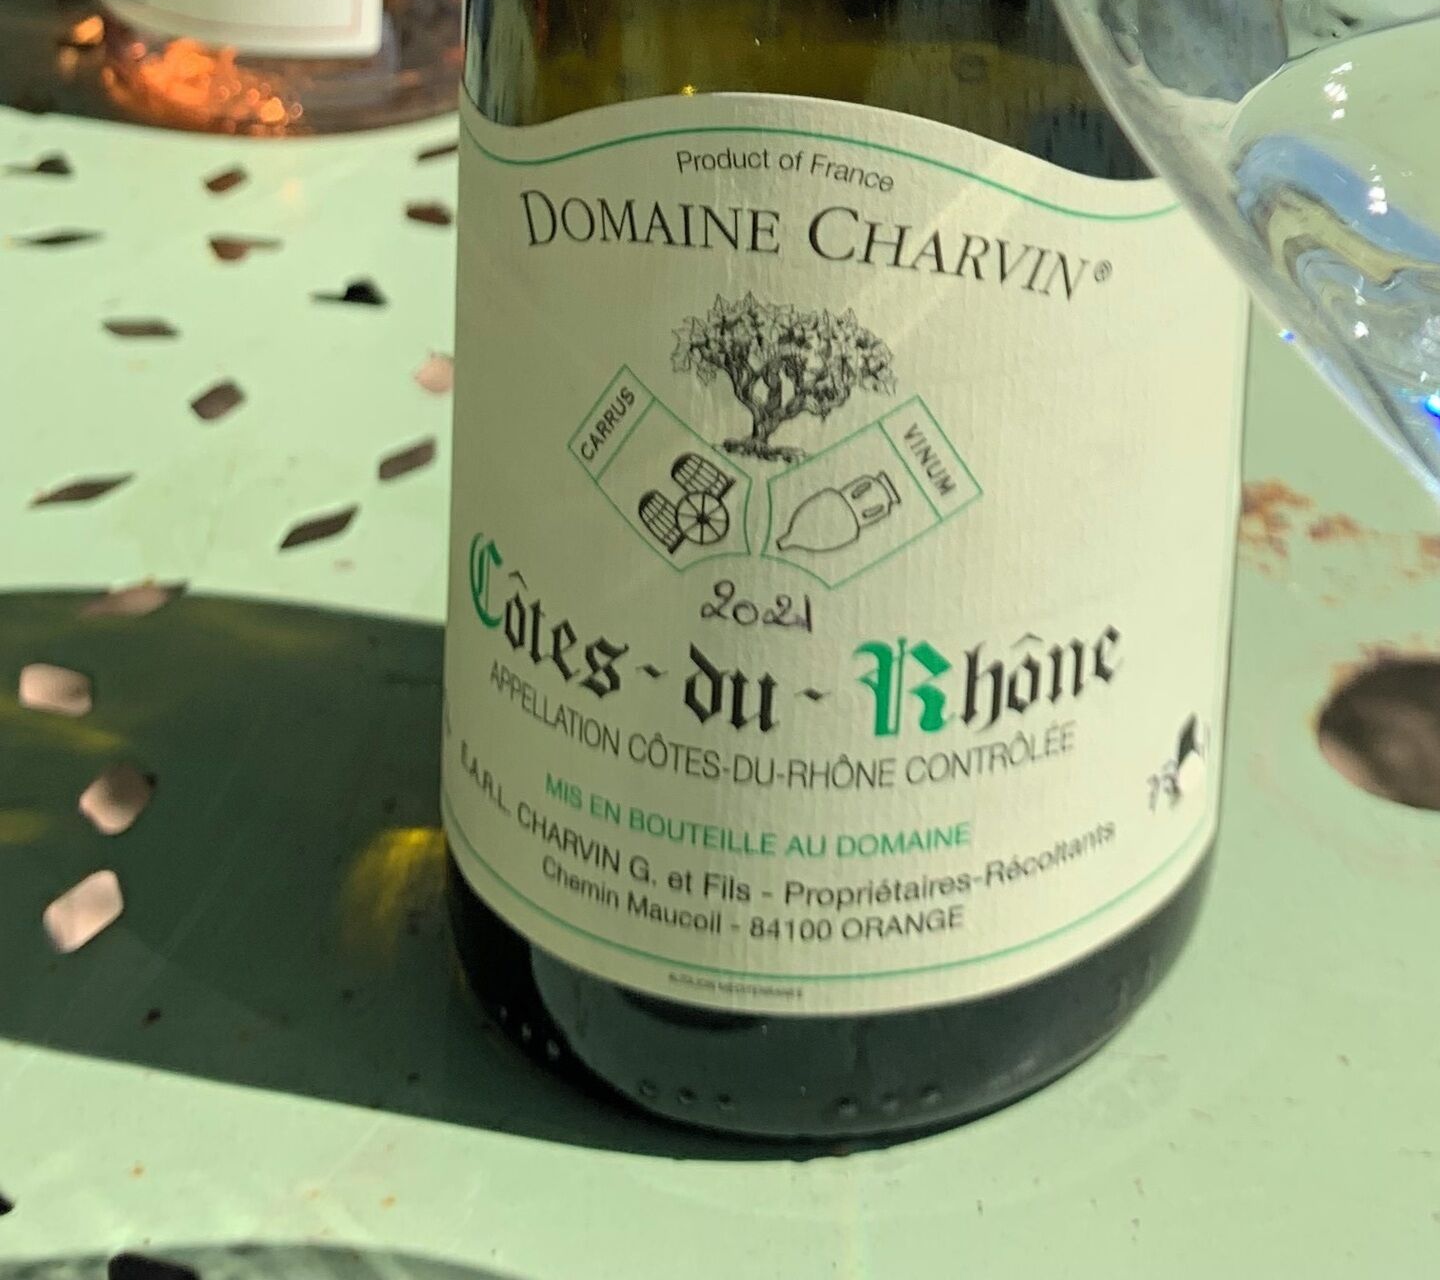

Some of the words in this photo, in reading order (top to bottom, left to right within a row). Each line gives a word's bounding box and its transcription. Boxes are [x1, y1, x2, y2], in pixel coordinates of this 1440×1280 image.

[676, 148, 770, 173] Product
[779, 151, 804, 171] of
[810, 153, 894, 191] France
[520, 190, 781, 254] DOMAINE
[580, 386, 636, 462] CARRUS
[903, 422, 958, 497] VINUM
[700, 580, 813, 633] 2021
[490, 660, 620, 757] APPELLATION
[628, 732, 897, 790] CÔTES-DU-RHÔNE
[906, 720, 1077, 785] CONTRÔLÉE
[545, 773, 583, 810] MIS
[590, 794, 622, 825] EN
[629, 809, 777, 856] BOUTEILLE
[784, 835, 827, 858] AU
[836, 822, 971, 858] DOMAINE
[517, 801, 621, 874] CHARVIN
[629, 855, 657, 886] G.
[668, 869, 692, 894] et
[704, 872, 750, 902] Fils
[784, 822, 1115, 913] Propriétaires-Récoltants
[542, 855, 619, 909] Chemin
[628, 892, 722, 934] Maucoil
[750, 916, 832, 941] 84100
[841, 904, 965, 941] ORANGE
